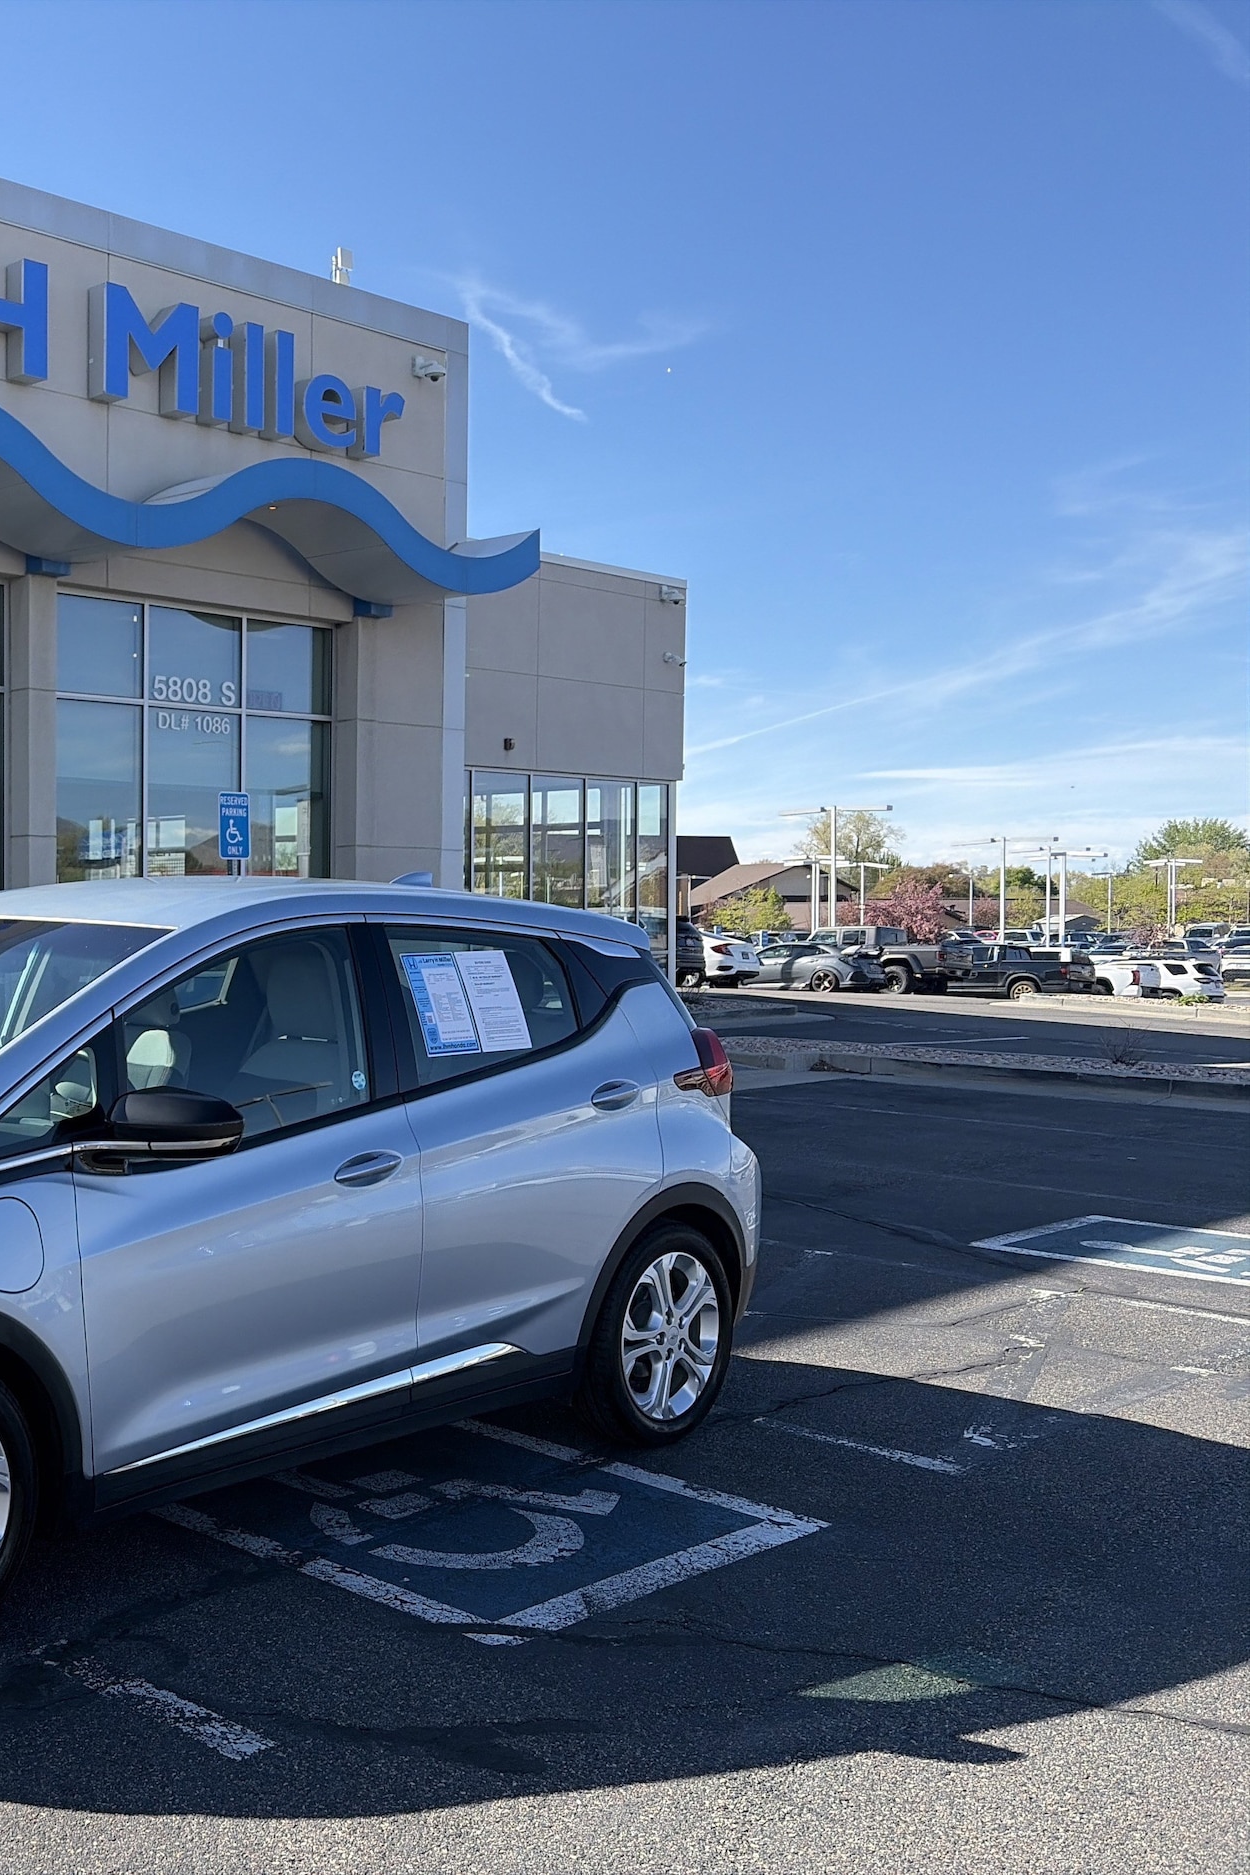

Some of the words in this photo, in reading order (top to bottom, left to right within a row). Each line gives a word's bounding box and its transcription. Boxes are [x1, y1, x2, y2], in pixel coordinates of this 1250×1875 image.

[92, 281, 406, 459] Miller
[153, 675, 211, 704] 5808
[221, 681, 236, 706] S
[158, 711, 189, 731] DL#
[195, 716, 230, 735] 1086
[220, 796, 247, 806] RESERVED
[222, 807, 247, 817] PARKING
[227, 845, 243, 855] ONLY
